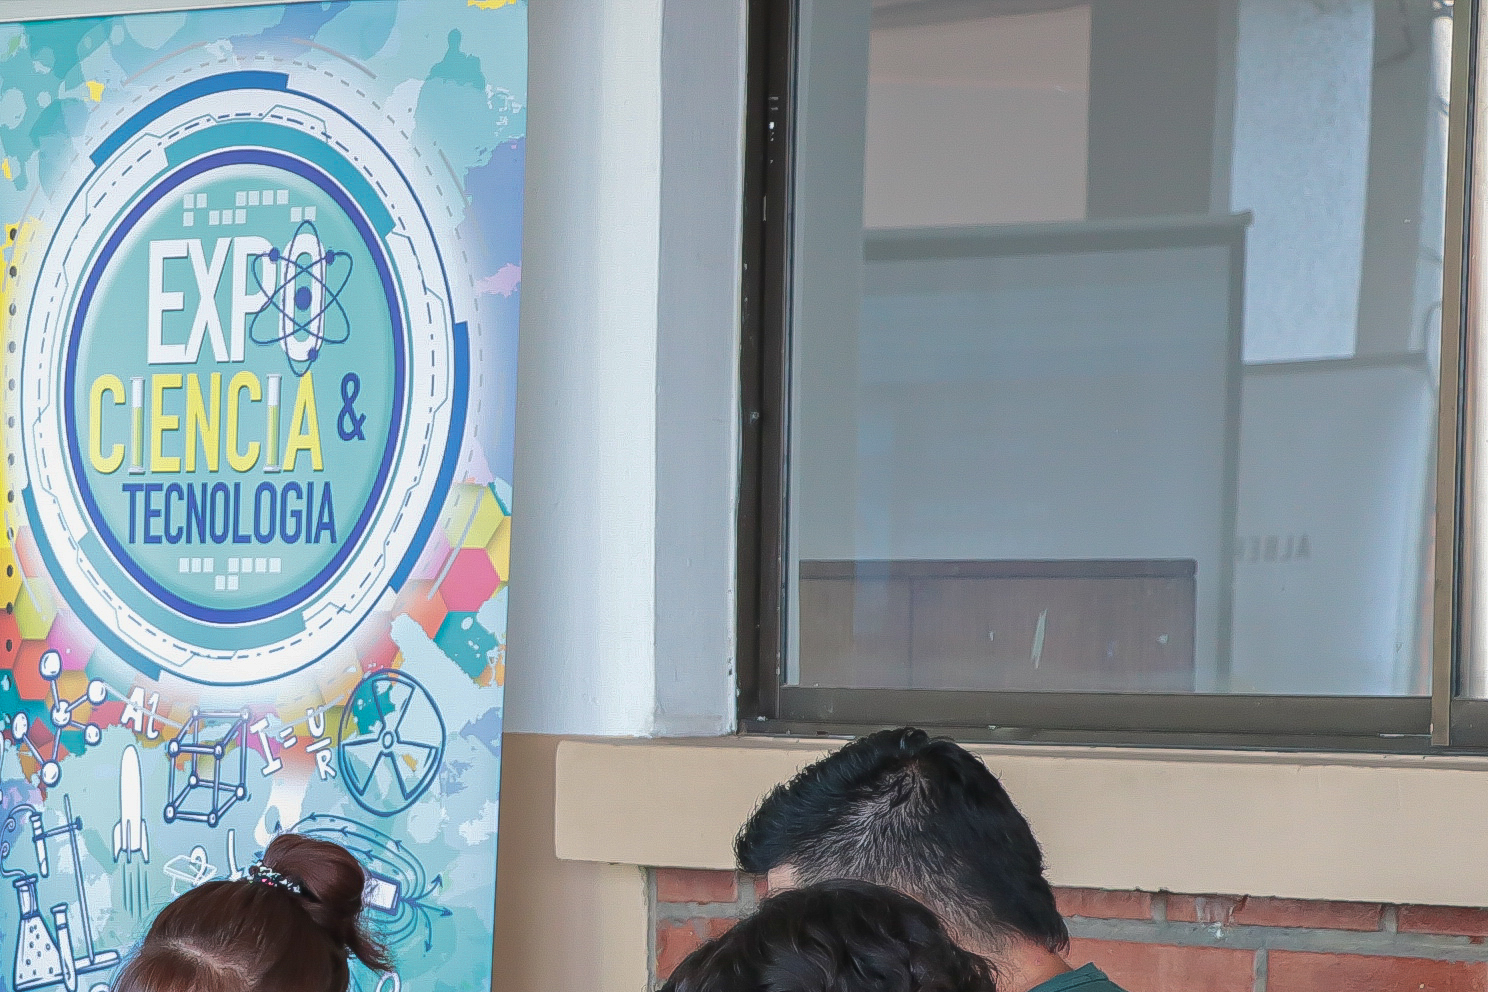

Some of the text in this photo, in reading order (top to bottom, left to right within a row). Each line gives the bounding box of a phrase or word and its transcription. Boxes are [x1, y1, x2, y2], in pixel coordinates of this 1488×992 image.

[147, 233, 327, 365] EXPO
[89, 370, 367, 475] CIENCIA &
[122, 481, 337, 545] TECNOLOGIA
